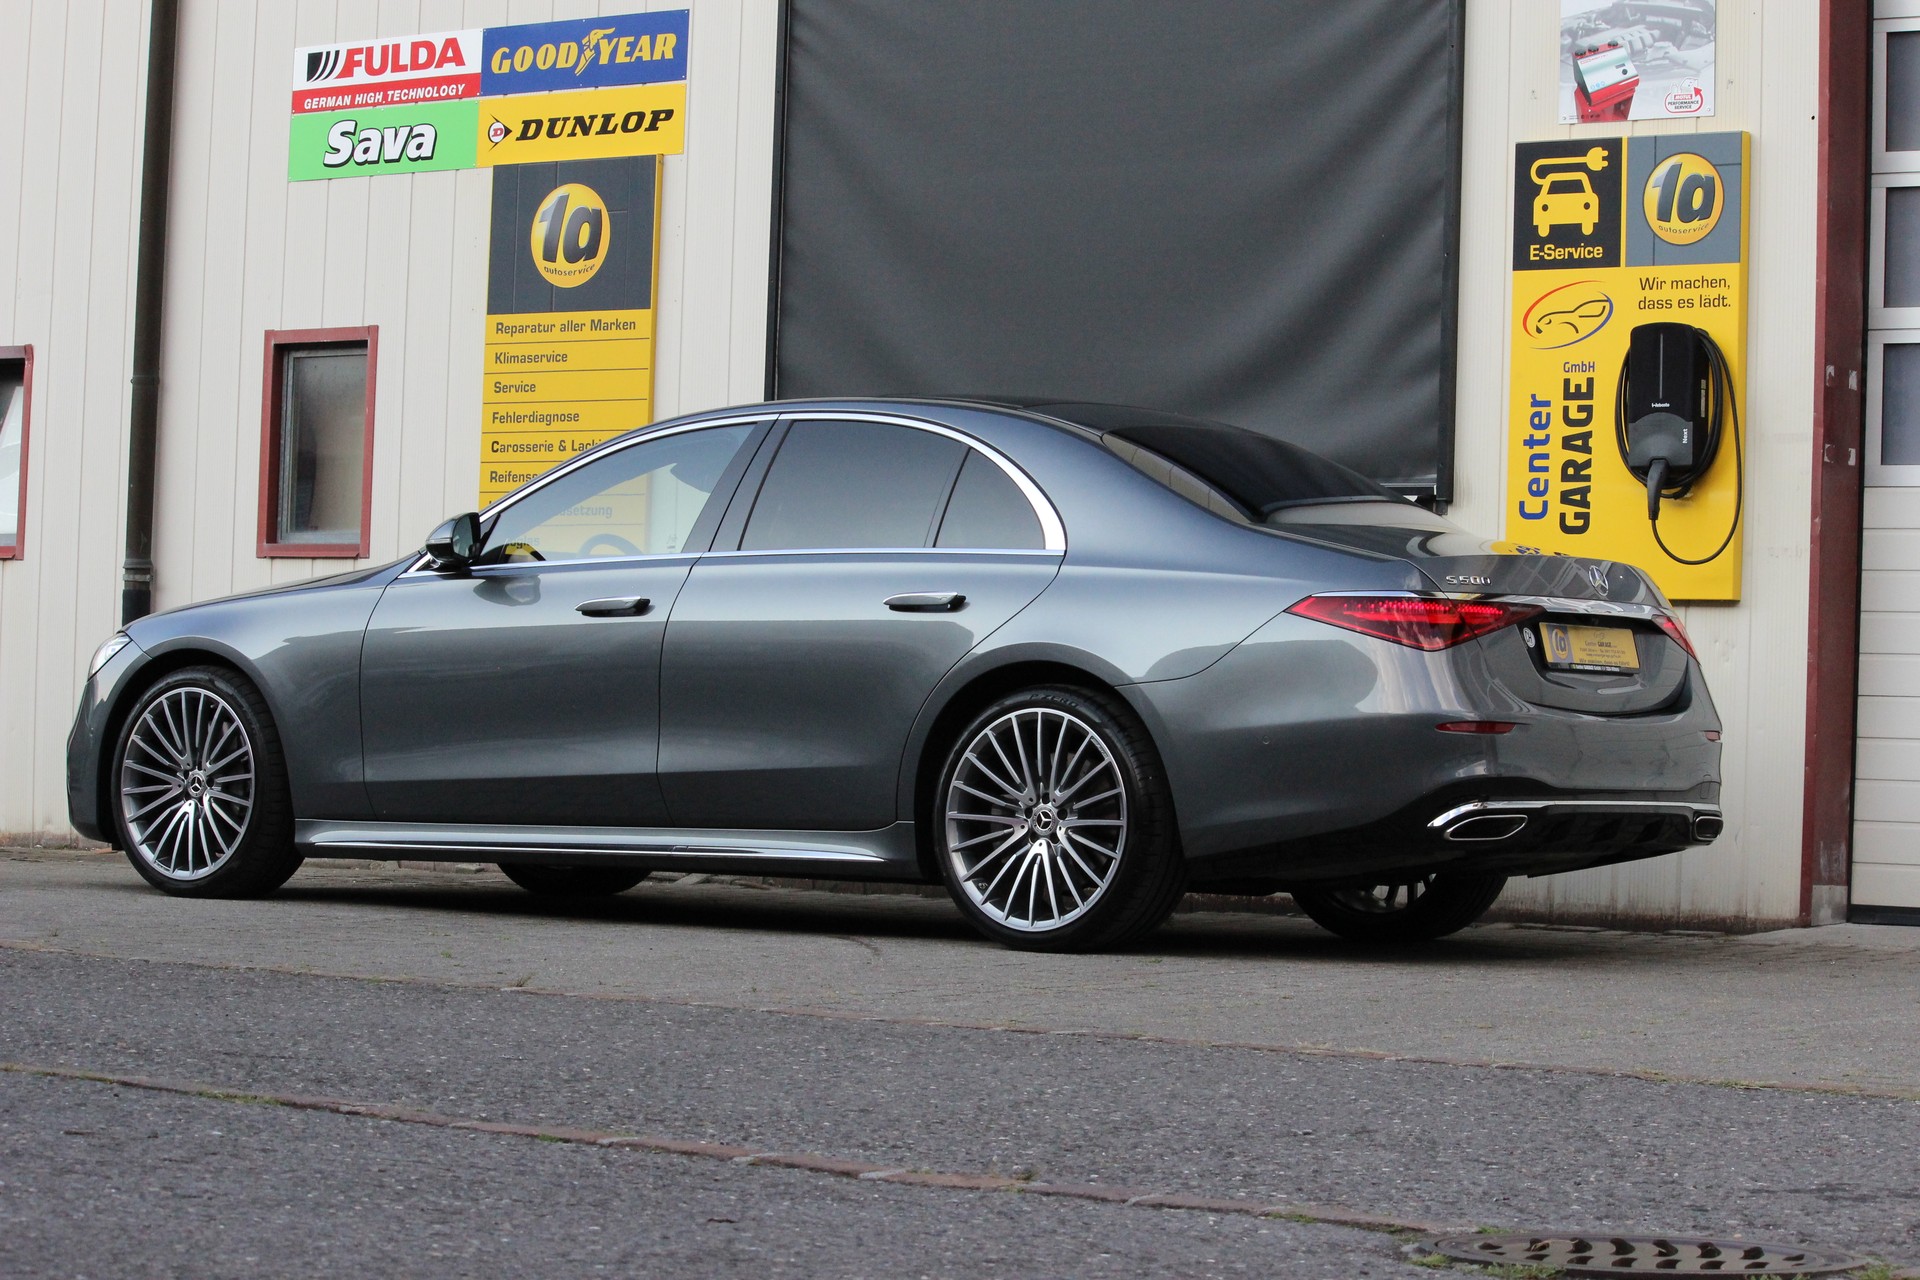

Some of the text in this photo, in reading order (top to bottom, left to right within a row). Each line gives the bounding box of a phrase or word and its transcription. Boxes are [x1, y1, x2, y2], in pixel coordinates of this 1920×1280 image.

[336, 37, 466, 79] FULDA
[304, 83, 466, 110] GERMAN HIGH TECHNOLOGY
[515, 109, 674, 142] DUNLOP
[323, 119, 438, 168] Sava
[1652, 162, 1716, 223] 1a
[538, 193, 602, 264] 1a
[1657, 222, 1710, 235] autoservice
[1529, 243, 1604, 261] E-Service
[543, 263, 596, 278] autoservice
[1639, 275, 1731, 291] Wir machen,
[1638, 294, 1732, 310] dass es lädt.
[495, 318, 637, 338] Reparatur aller Marken
[494, 350, 569, 365] Klimaservice
[493, 380, 537, 394] Service
[492, 410, 580, 426] Fehlerdiagnose
[490, 440, 554, 453] Carosserie
[558, 439, 567, 452] &
[1559, 361, 1596, 536] GARAGE GmbH
[1518, 393, 1552, 521] Center
